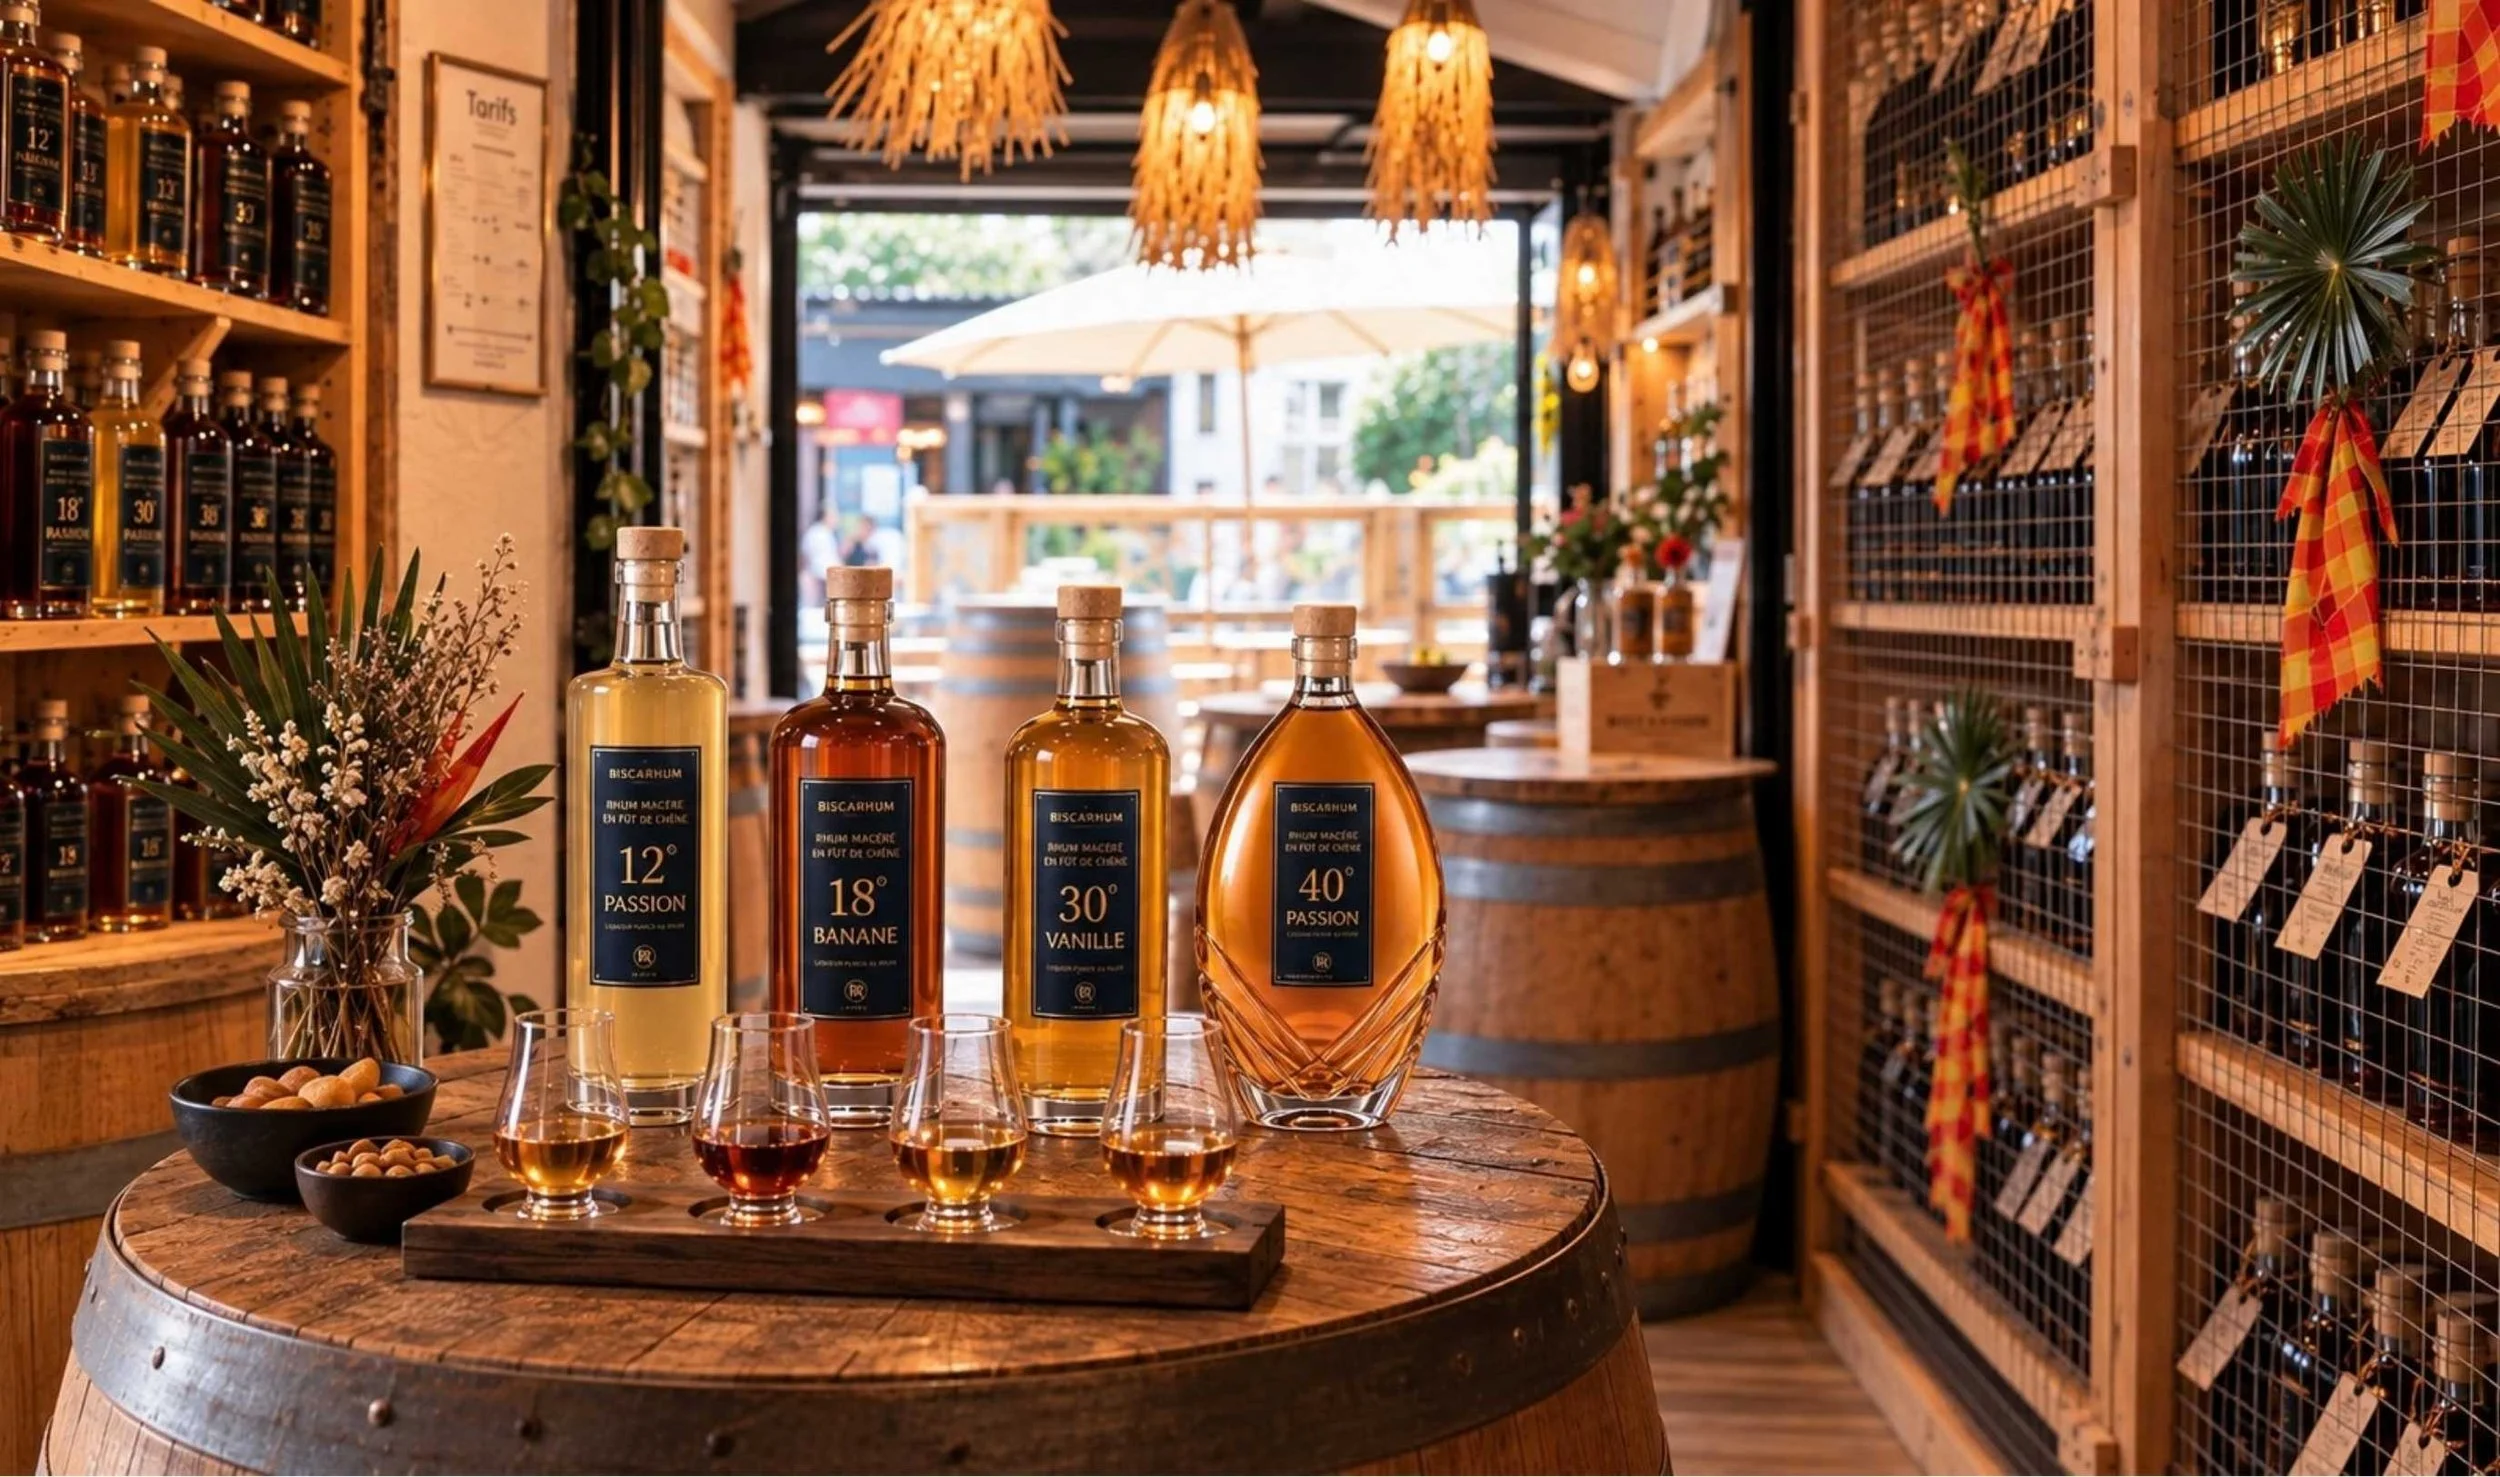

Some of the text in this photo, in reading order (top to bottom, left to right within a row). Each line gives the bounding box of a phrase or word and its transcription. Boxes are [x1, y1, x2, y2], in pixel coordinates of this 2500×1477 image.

[465, 89, 517, 126] Tarifs
[608, 768, 682, 779] BISCARHUM
[817, 801, 895, 812] BISCARHUM
[1290, 802, 1358, 813] BISCARHUM
[1050, 812, 1123, 822] BISCARHUM
[850, 848, 863, 859] DE
[604, 894, 686, 913] PASSION
[1286, 910, 1359, 926] PASSION
[813, 926, 898, 945] BANANE
[1045, 931, 1125, 950] VANILLE
